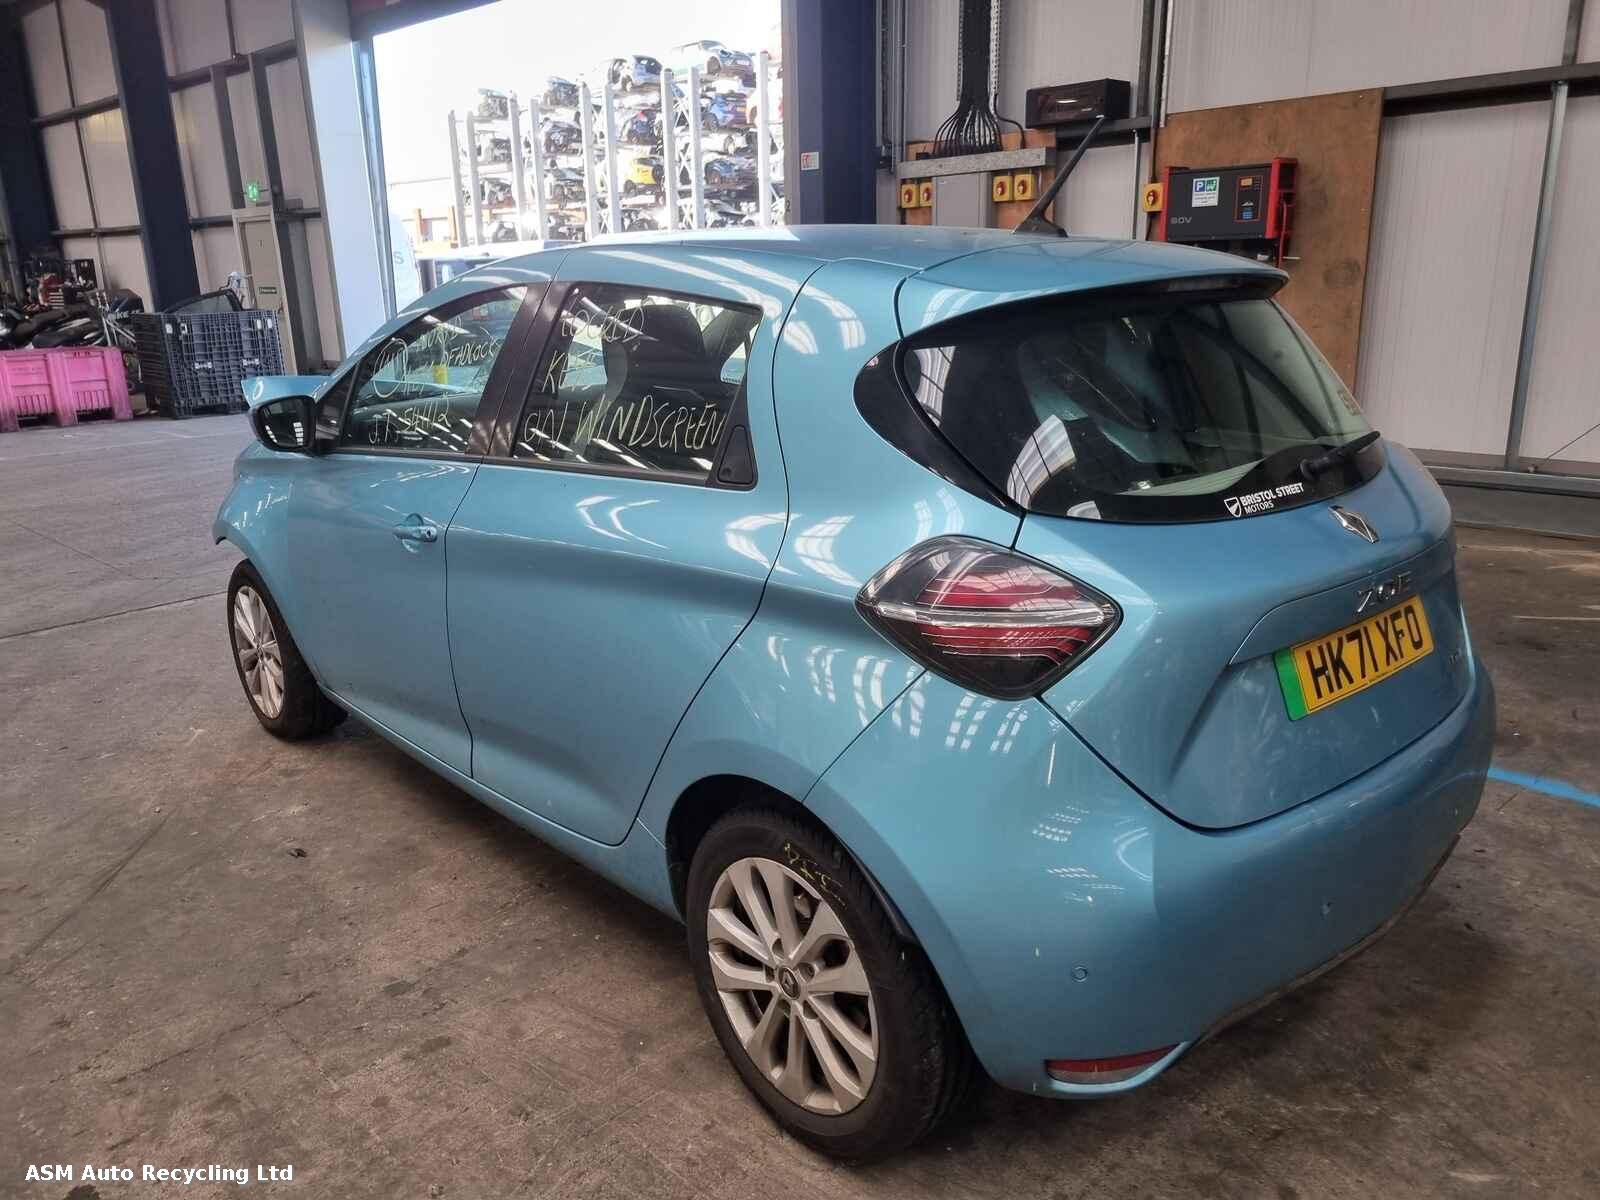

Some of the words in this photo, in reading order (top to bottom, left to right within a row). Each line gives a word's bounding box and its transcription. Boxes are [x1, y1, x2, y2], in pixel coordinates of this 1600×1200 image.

[574, 394, 727, 453] WINDSCREEN
[1240, 489, 1277, 506] BRISTOL
[1275, 482, 1304, 497] STREET
[1243, 500, 1274, 514] MOTORS
